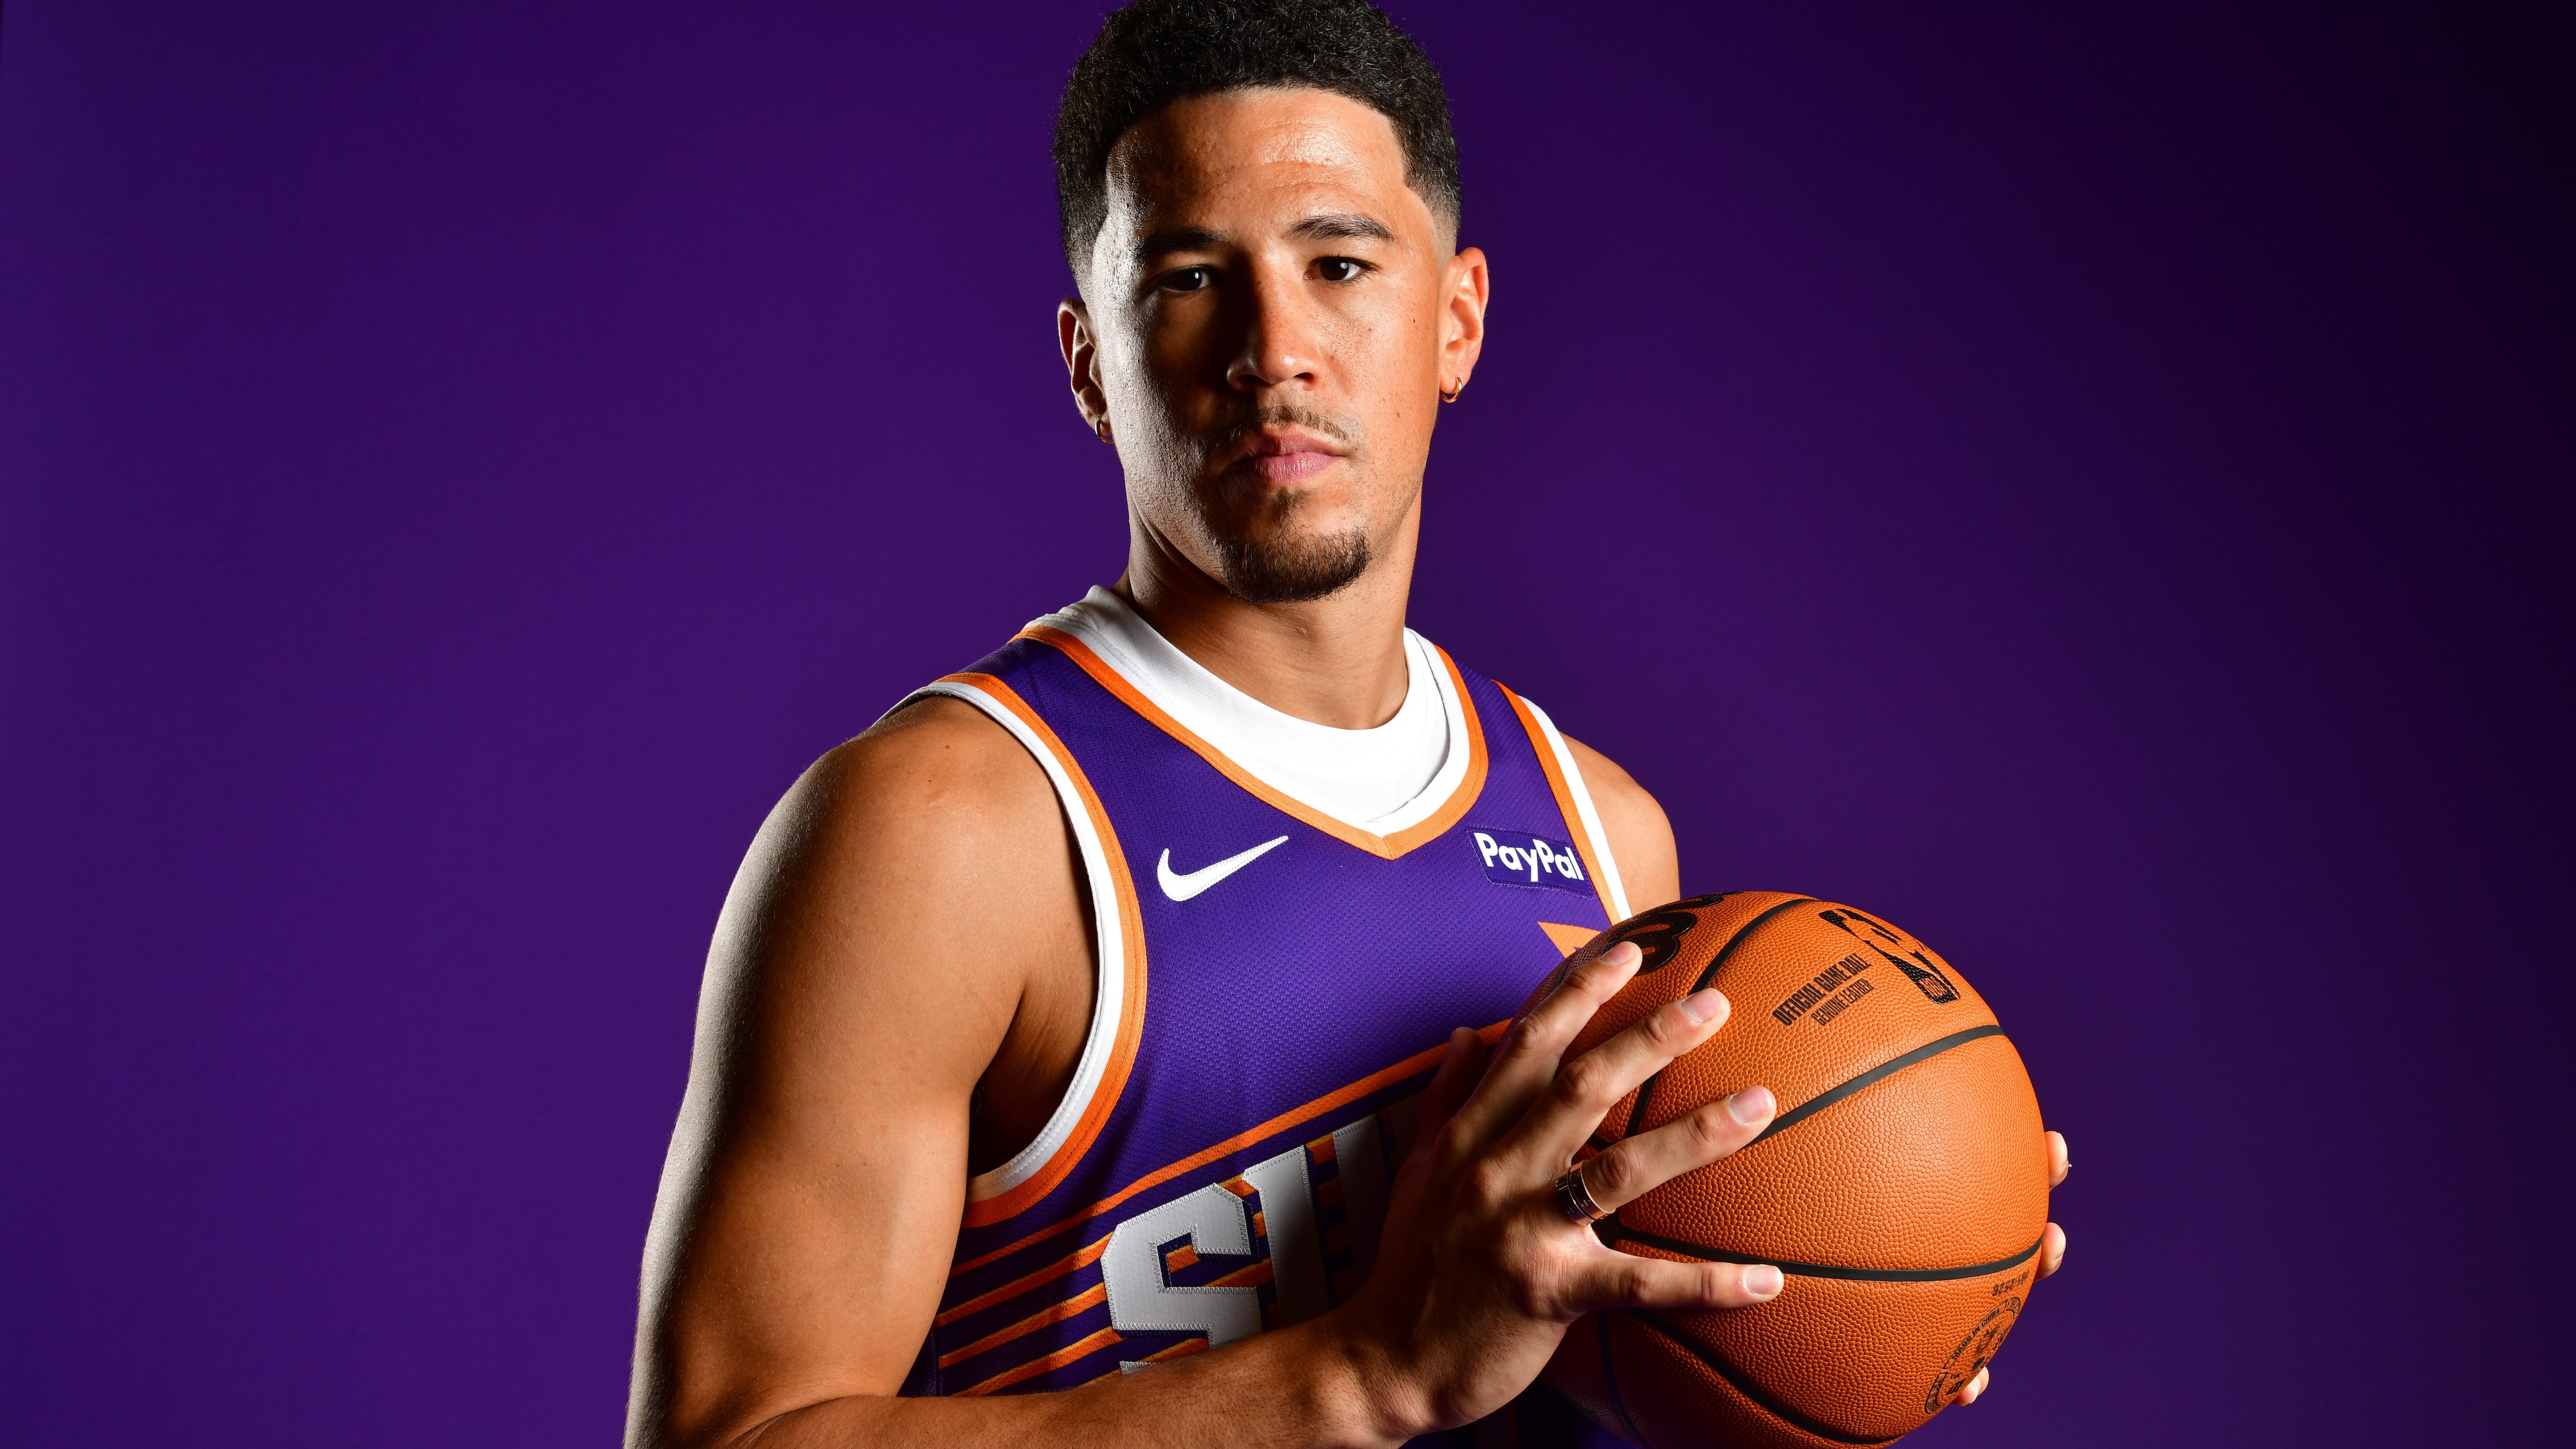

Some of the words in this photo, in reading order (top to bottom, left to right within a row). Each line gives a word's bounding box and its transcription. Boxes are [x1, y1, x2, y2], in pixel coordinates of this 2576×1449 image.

[1473, 832, 1584, 882] PayPal
[1772, 983, 1826, 1026] OFFICIAL
[1813, 964, 1852, 992] GAME
[1838, 953, 1872, 975] BALL
[1810, 994, 1849, 1026] GENUINE
[1839, 978, 1874, 1004] LEATHER
[1100, 1095, 1425, 1375] SU
[1952, 1335, 1972, 1360] MADE
[1972, 1325, 1980, 1337] IN
[1981, 1307, 1999, 1327] CHINA
